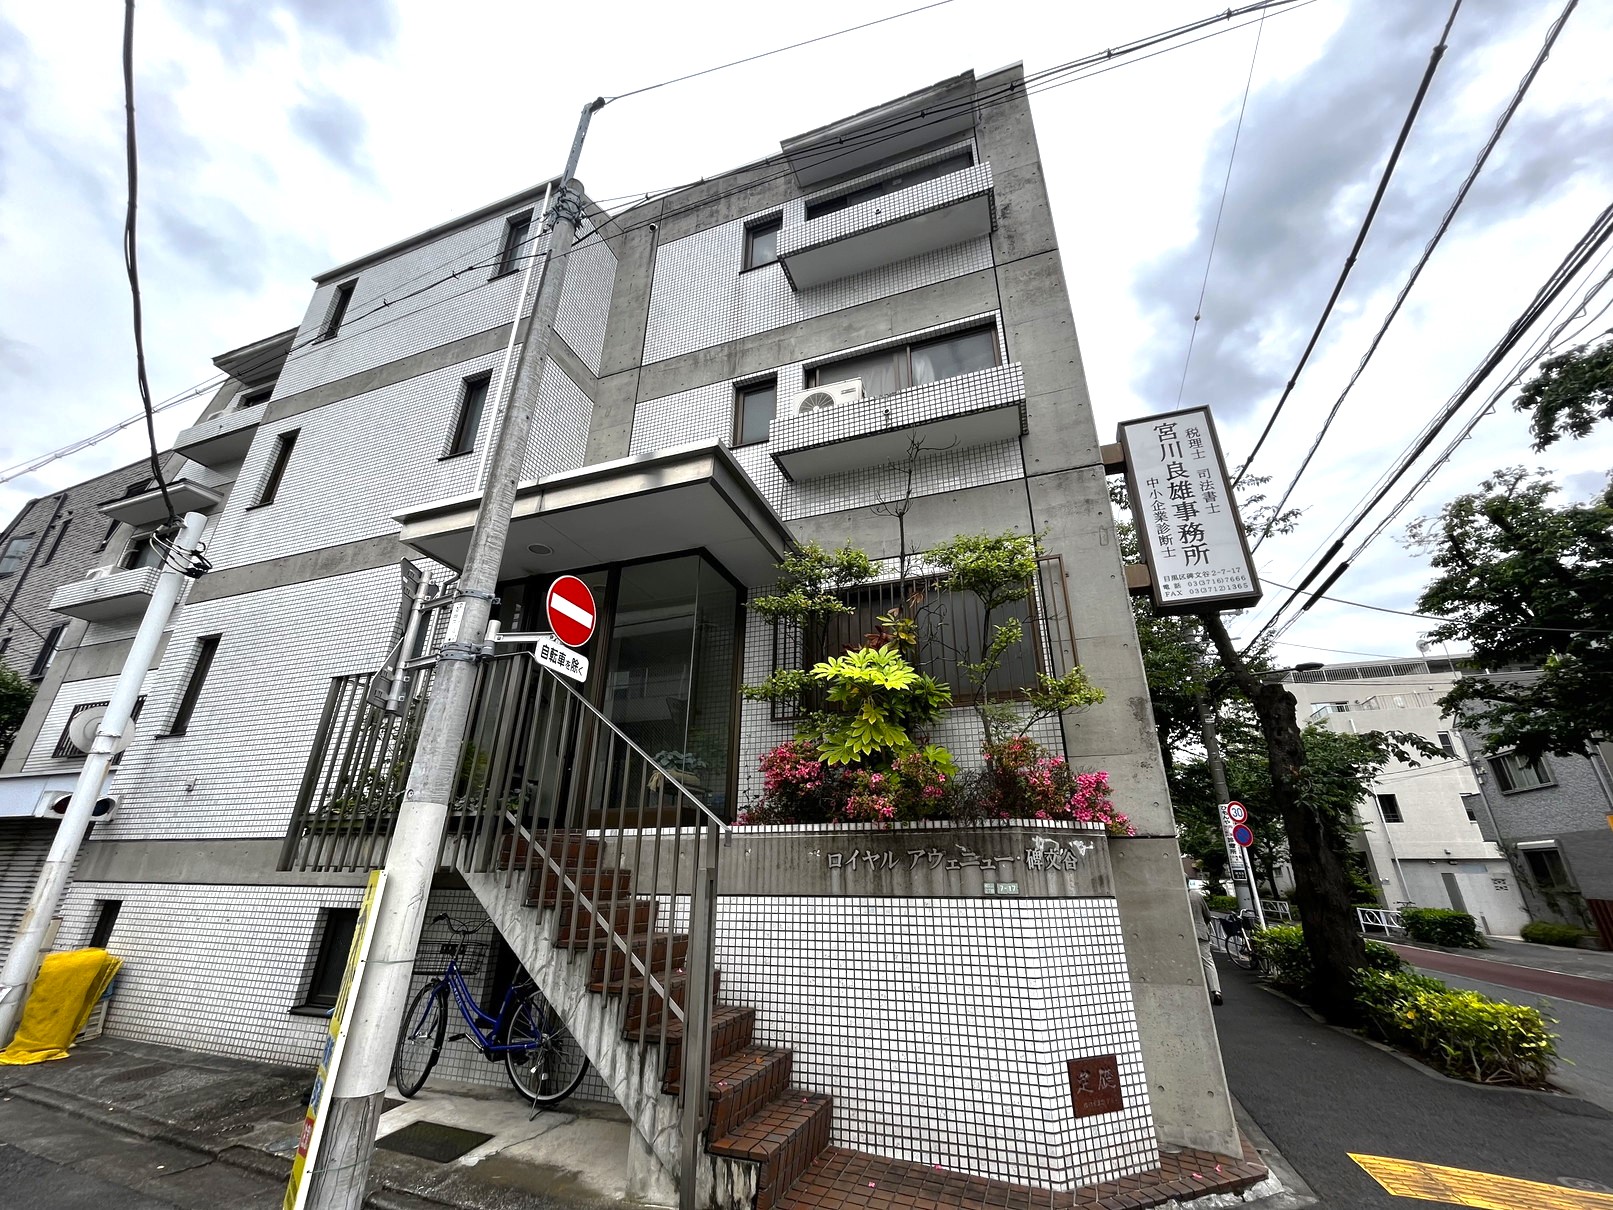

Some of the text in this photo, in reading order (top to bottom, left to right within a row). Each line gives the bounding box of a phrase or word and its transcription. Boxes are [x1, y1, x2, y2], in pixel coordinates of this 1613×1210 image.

[1185, 427, 1220, 515] 税理士 司法書士
[1153, 422, 1210, 567] 宮川良雄事務所
[1146, 477, 1177, 558] 中小企業診断士
[540, 644, 584, 676] 自転車を除く
[1231, 807, 1243, 818] 30
[828, 849, 900, 871] ロイヤル
[1000, 884, 1017, 892] 7-17
